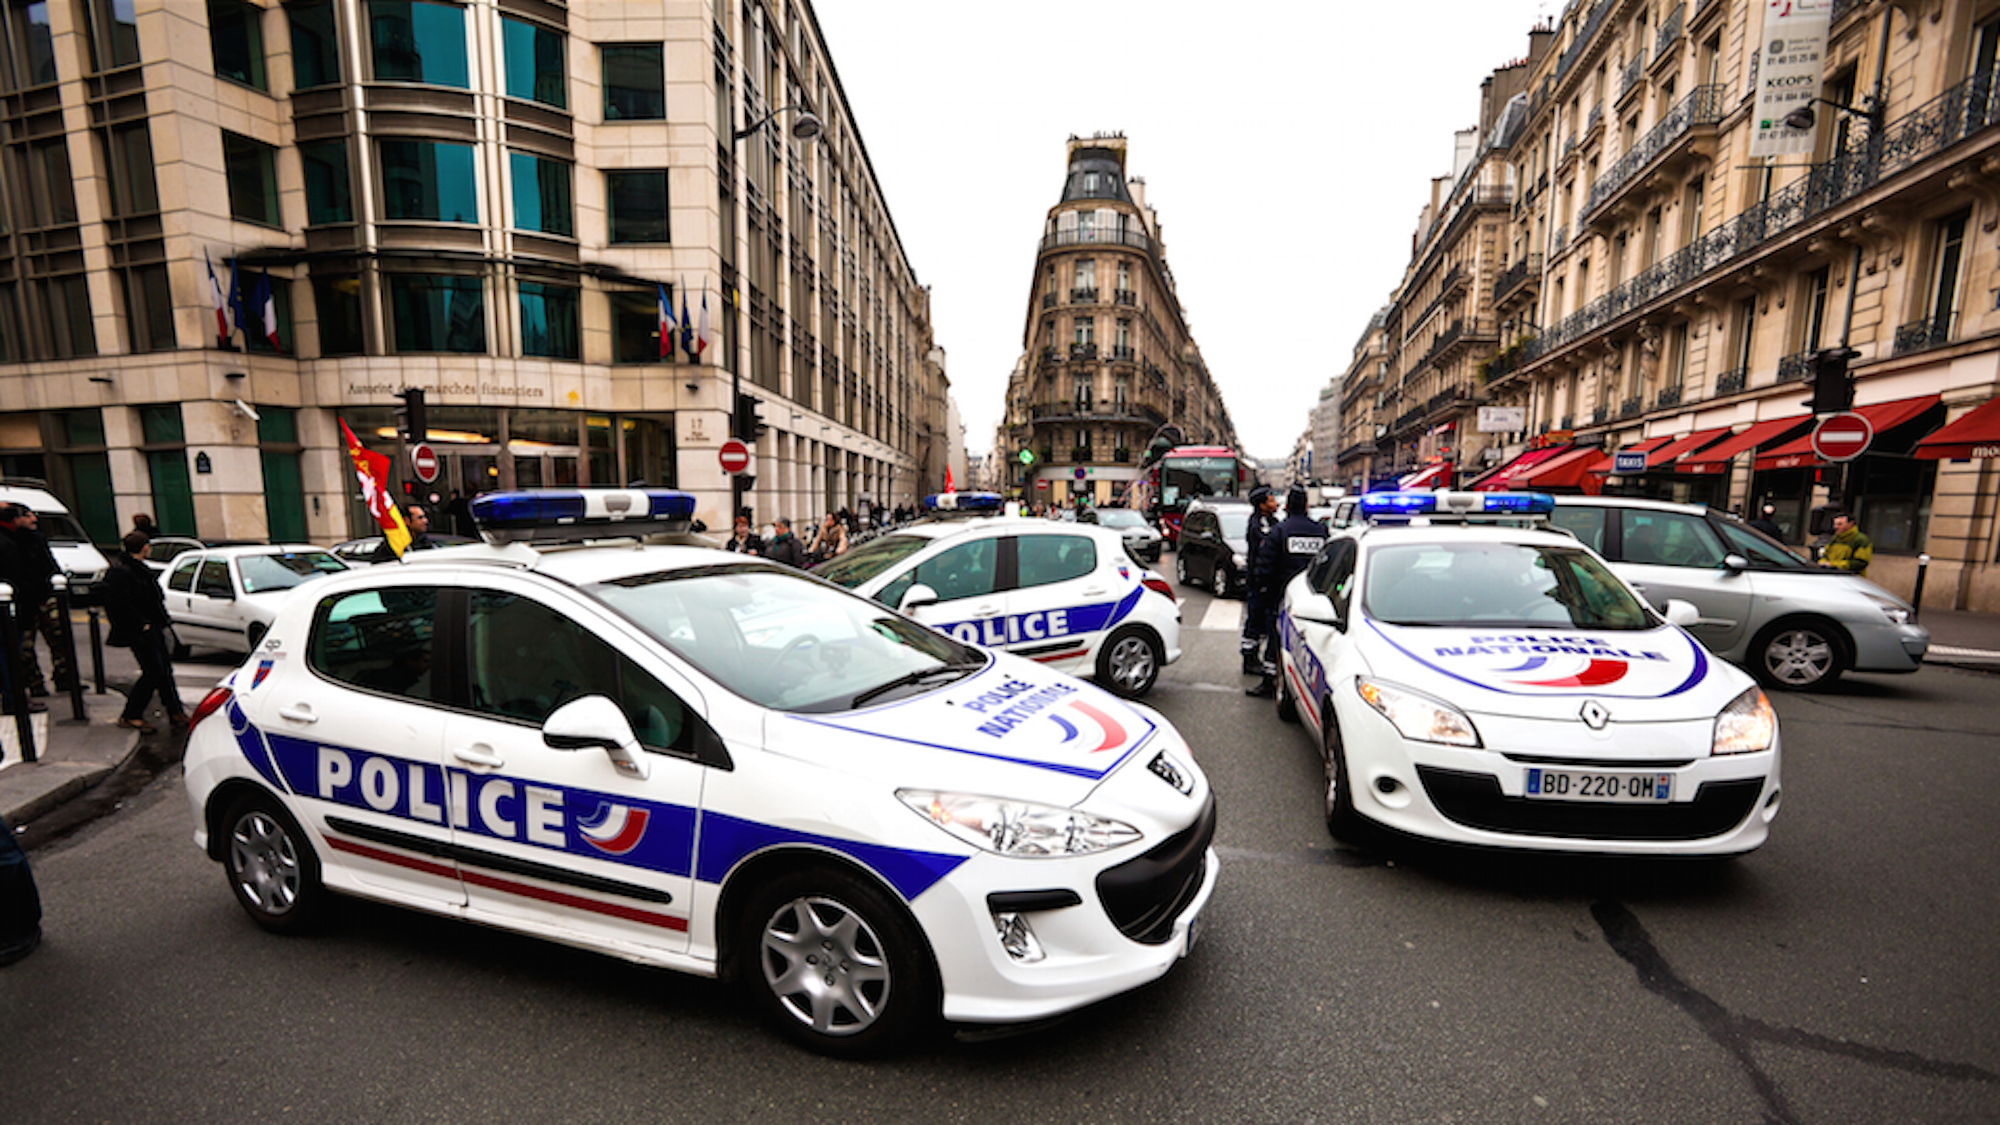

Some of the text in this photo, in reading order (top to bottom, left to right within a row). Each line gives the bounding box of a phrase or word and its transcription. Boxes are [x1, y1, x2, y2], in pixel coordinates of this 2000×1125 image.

[1766, 75, 1813, 87] KEOPS
[481, 383, 545, 397] financiers
[1470, 635, 1611, 646] POLICE
[1434, 645, 1670, 662] NATIONALE
[963, 680, 1035, 713] POLICE
[976, 683, 1079, 738] NATIONALE
[318, 747, 566, 848] POLICE
